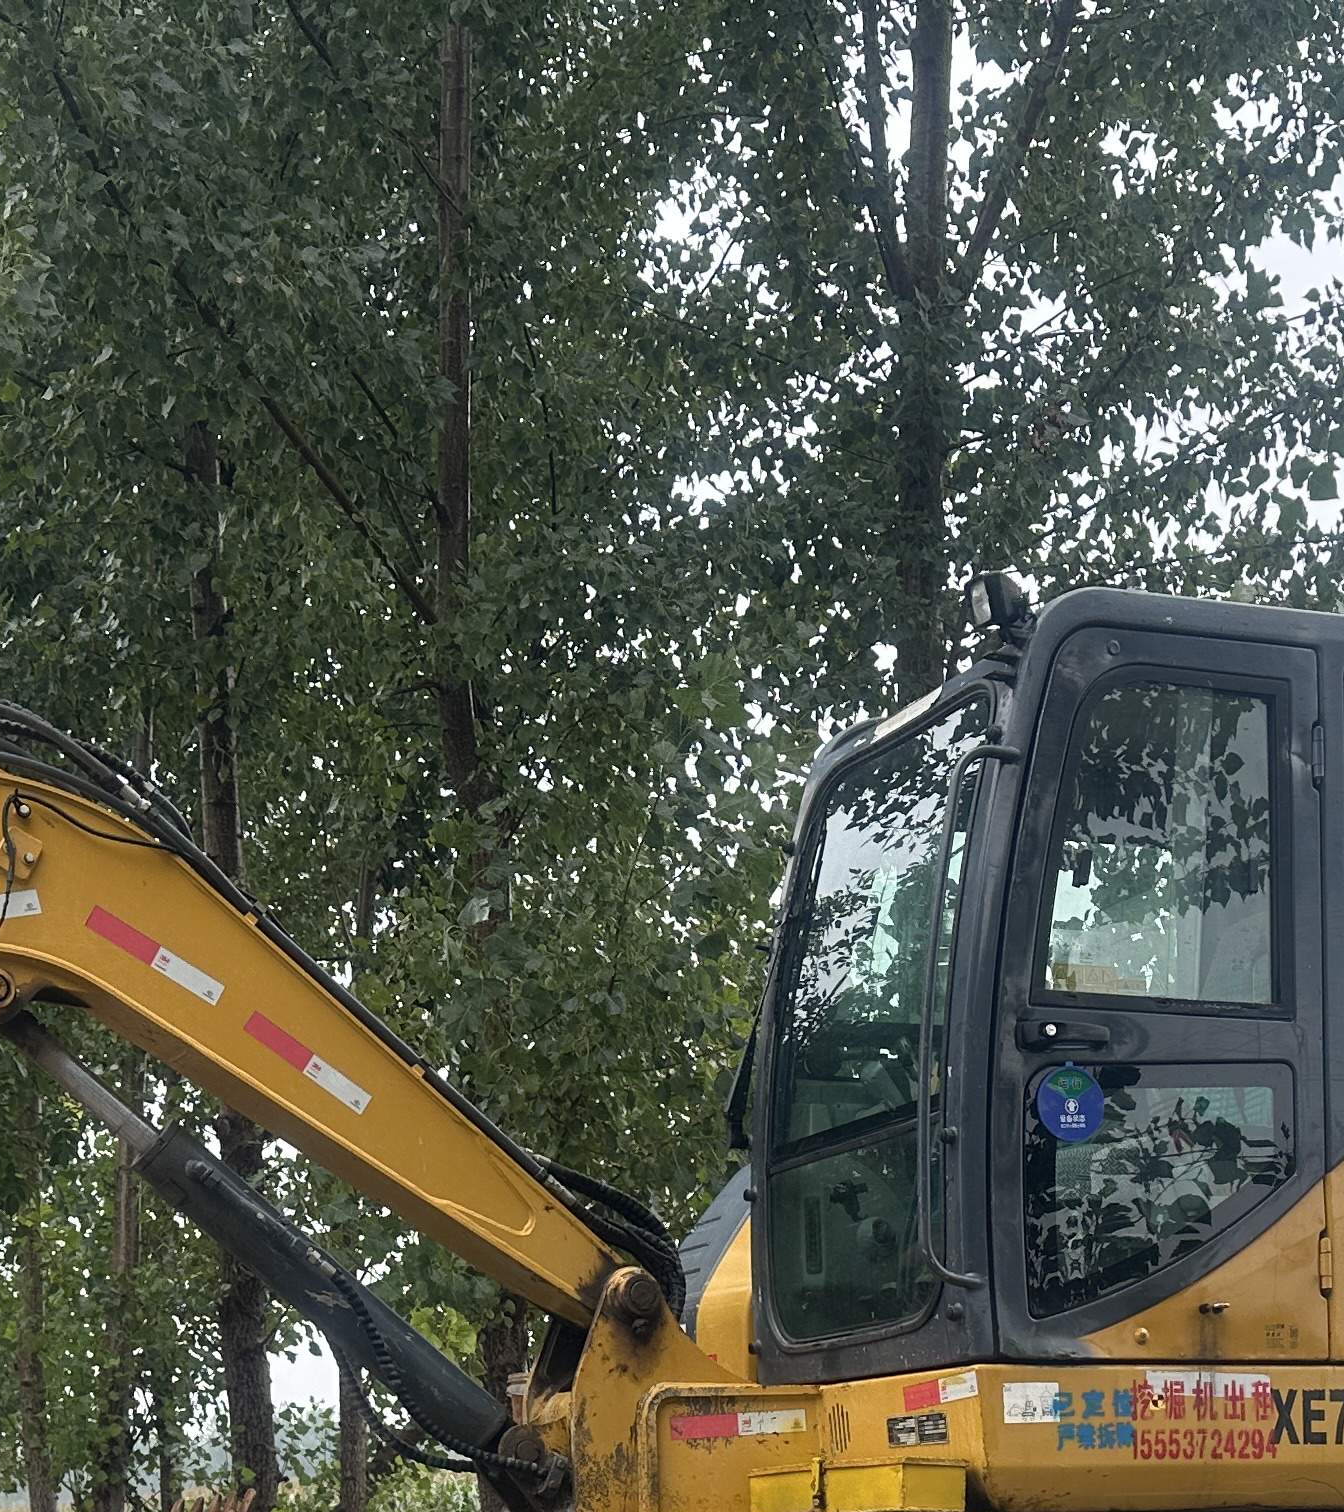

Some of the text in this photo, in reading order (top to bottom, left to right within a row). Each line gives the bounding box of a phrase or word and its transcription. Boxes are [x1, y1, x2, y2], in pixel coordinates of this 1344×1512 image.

[1131, 1379, 1275, 1422] 挖掘机出租
[1132, 1428, 1278, 1461] 15553724294
